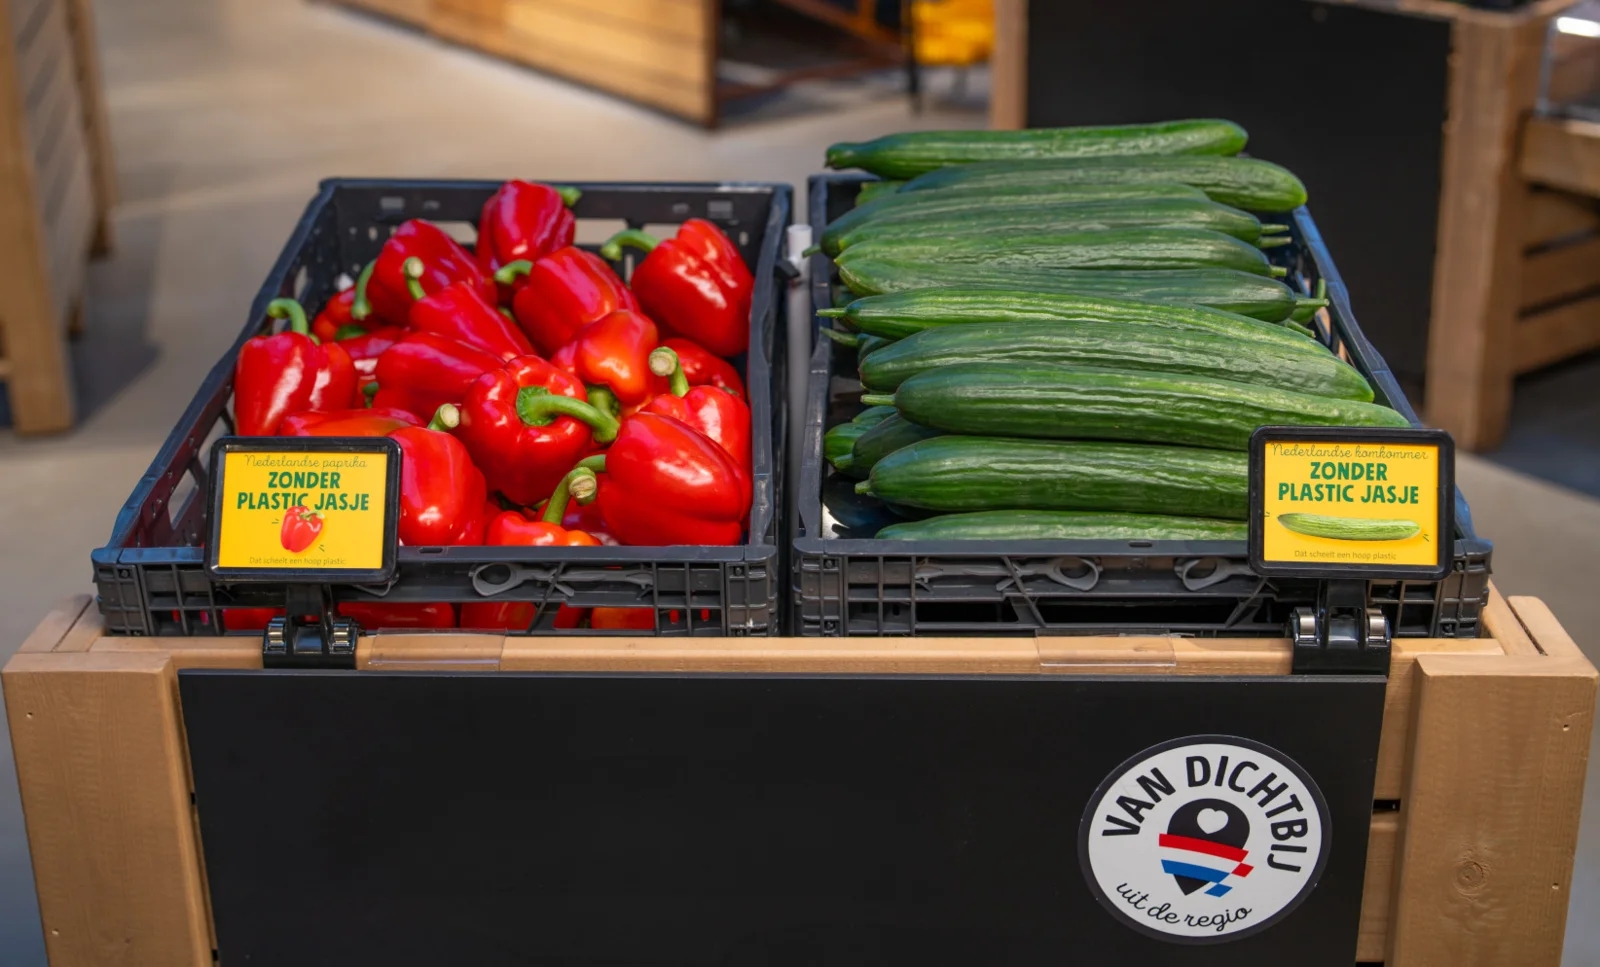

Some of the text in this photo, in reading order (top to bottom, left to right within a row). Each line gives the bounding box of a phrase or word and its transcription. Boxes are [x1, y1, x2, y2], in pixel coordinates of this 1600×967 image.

[1271, 443, 1429, 460] Nederlandse komkommer
[244, 455, 367, 470] Nederlandse paprika
[1310, 461, 1388, 481] ZONDER
[268, 471, 341, 489] ZONDER
[237, 492, 369, 511] PLASTIC JASJE
[1278, 482, 1419, 504] PLASTIC JASJE
[249, 556, 262, 564] Dat
[304, 557, 322, 566] hoop
[323, 557, 346, 566] plastic
[1294, 550, 1307, 558] Dat
[1309, 550, 1336, 559] scheelt
[1352, 551, 1371, 561] hoop
[1373, 552, 1397, 561] plastic
[1101, 755, 1309, 873] VAN DICHTBIJ
[1116, 882, 1252, 931] uit de regio
